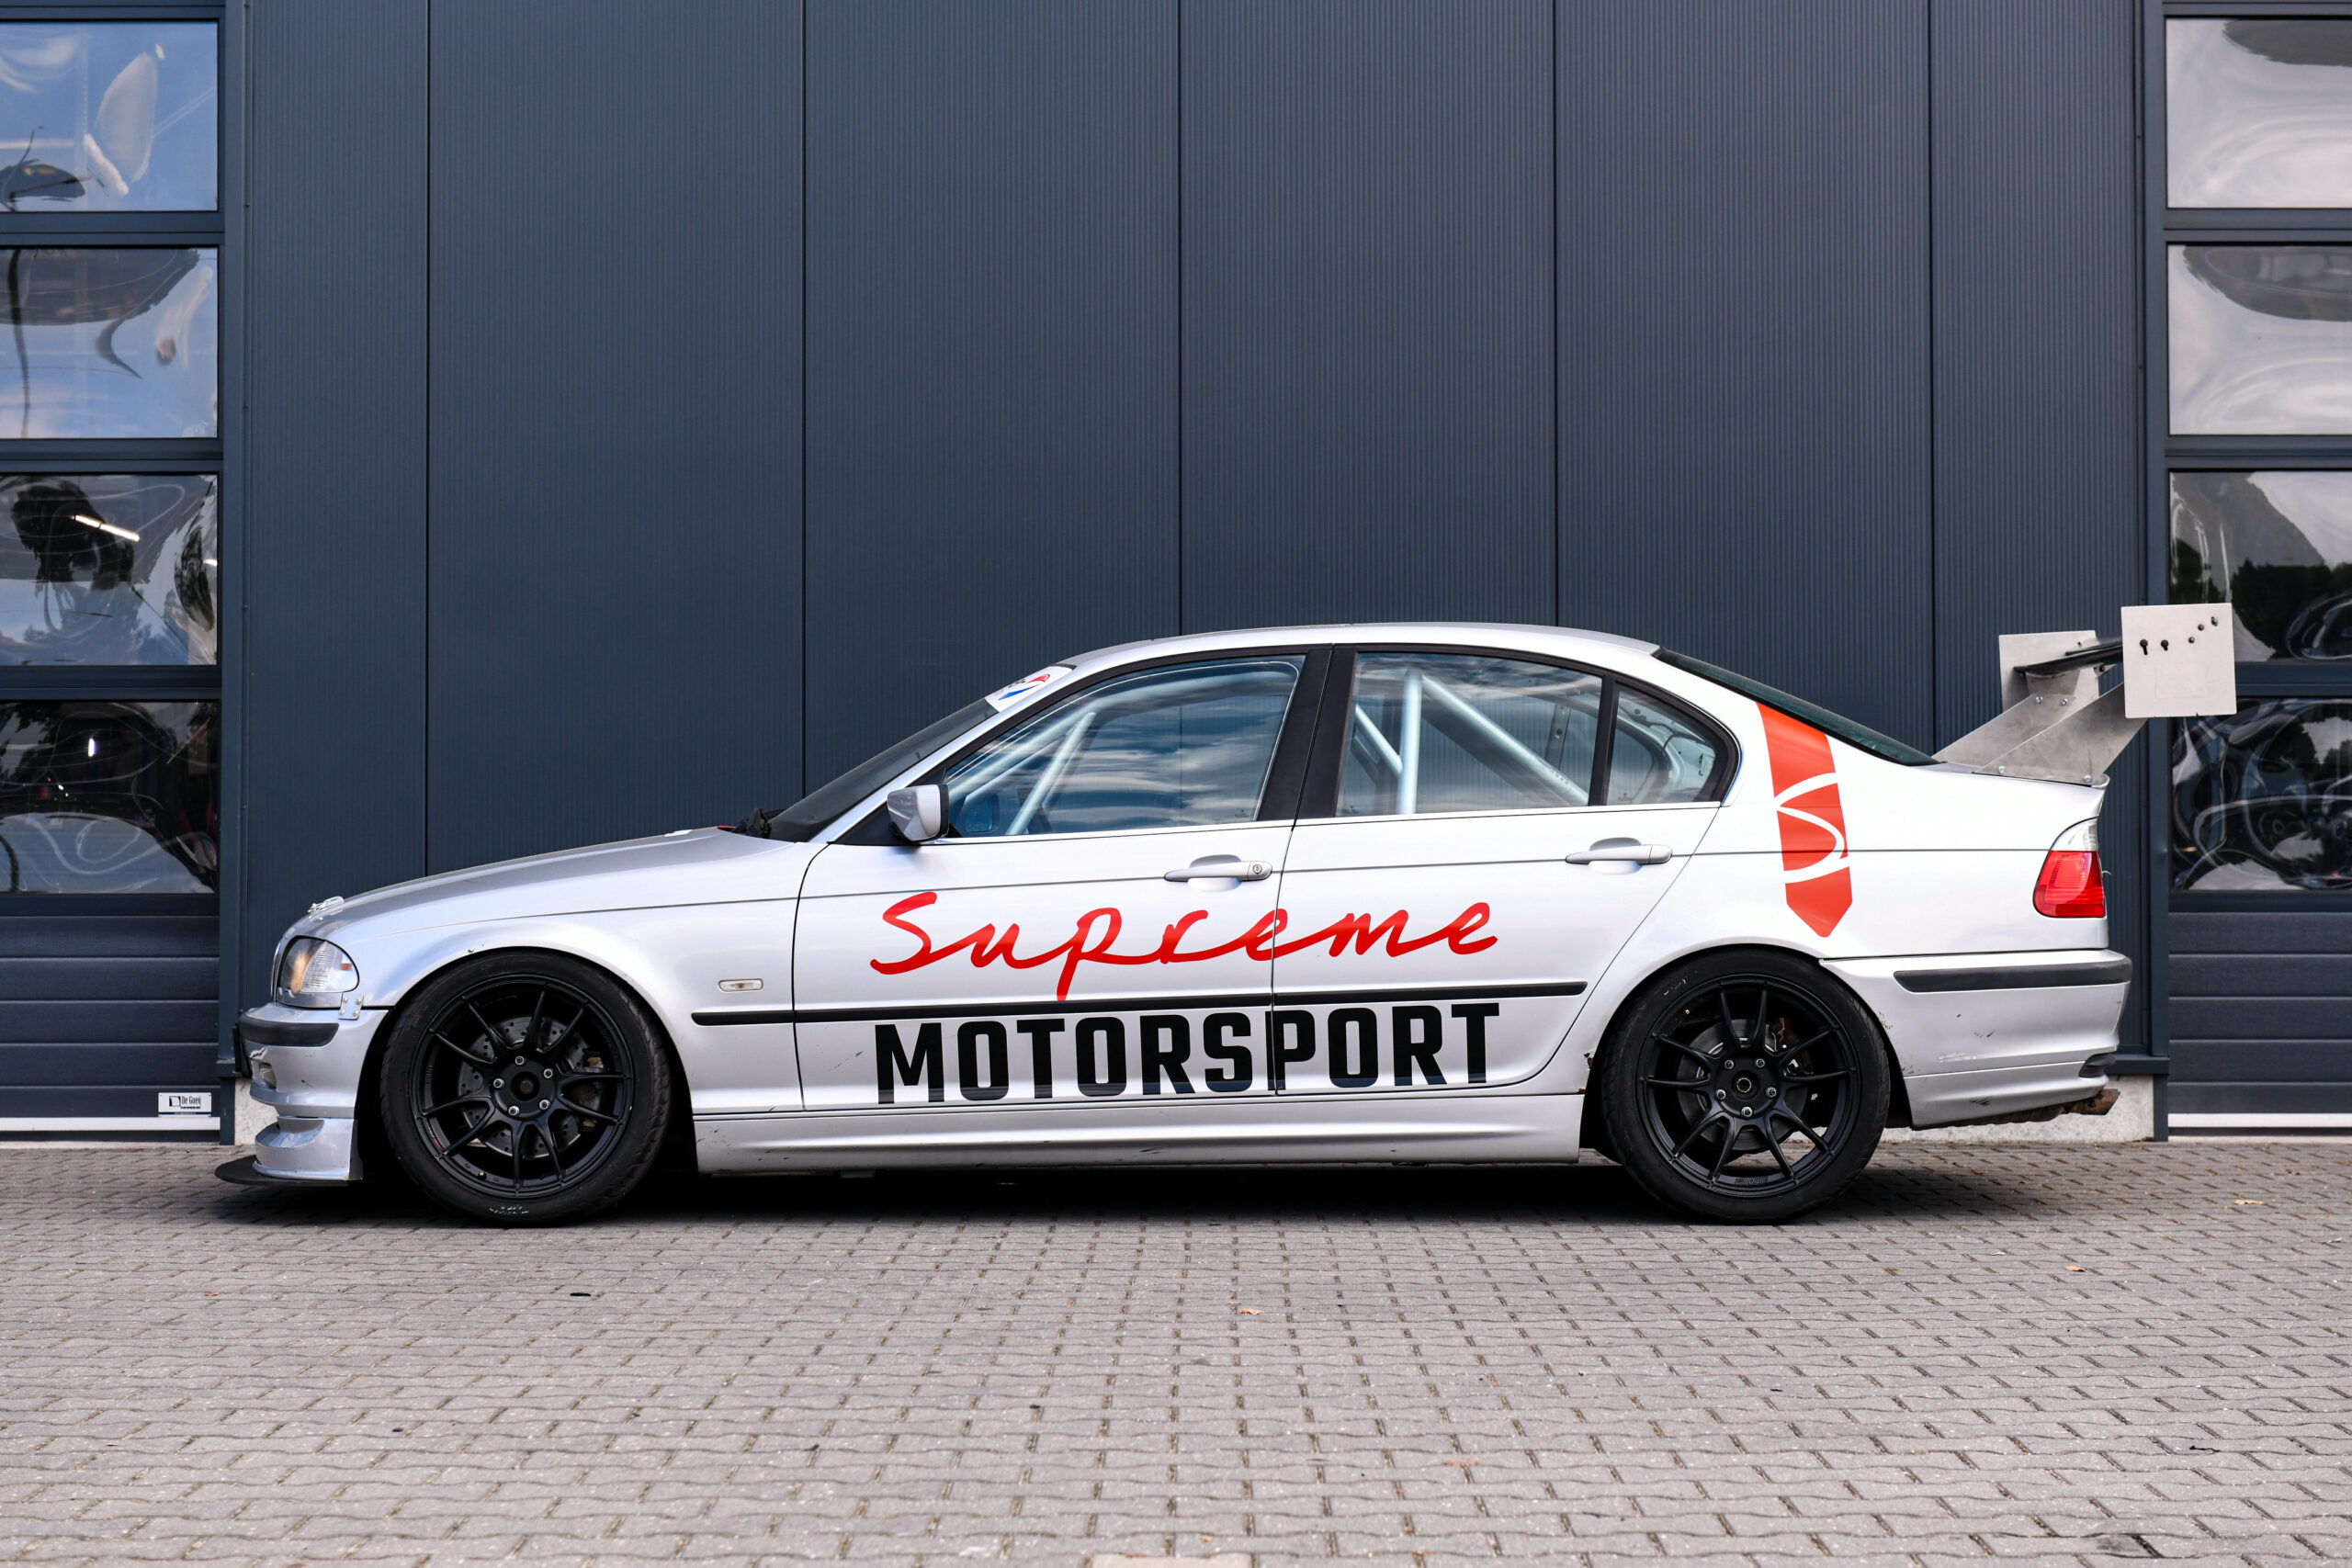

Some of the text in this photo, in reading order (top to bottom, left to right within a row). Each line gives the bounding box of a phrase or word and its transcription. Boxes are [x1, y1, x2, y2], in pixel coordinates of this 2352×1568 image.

[869, 891, 1498, 1001] Supreme
[182, 1096, 188, 1105] De
[875, 1002, 1499, 1105] MOTORSPORT
